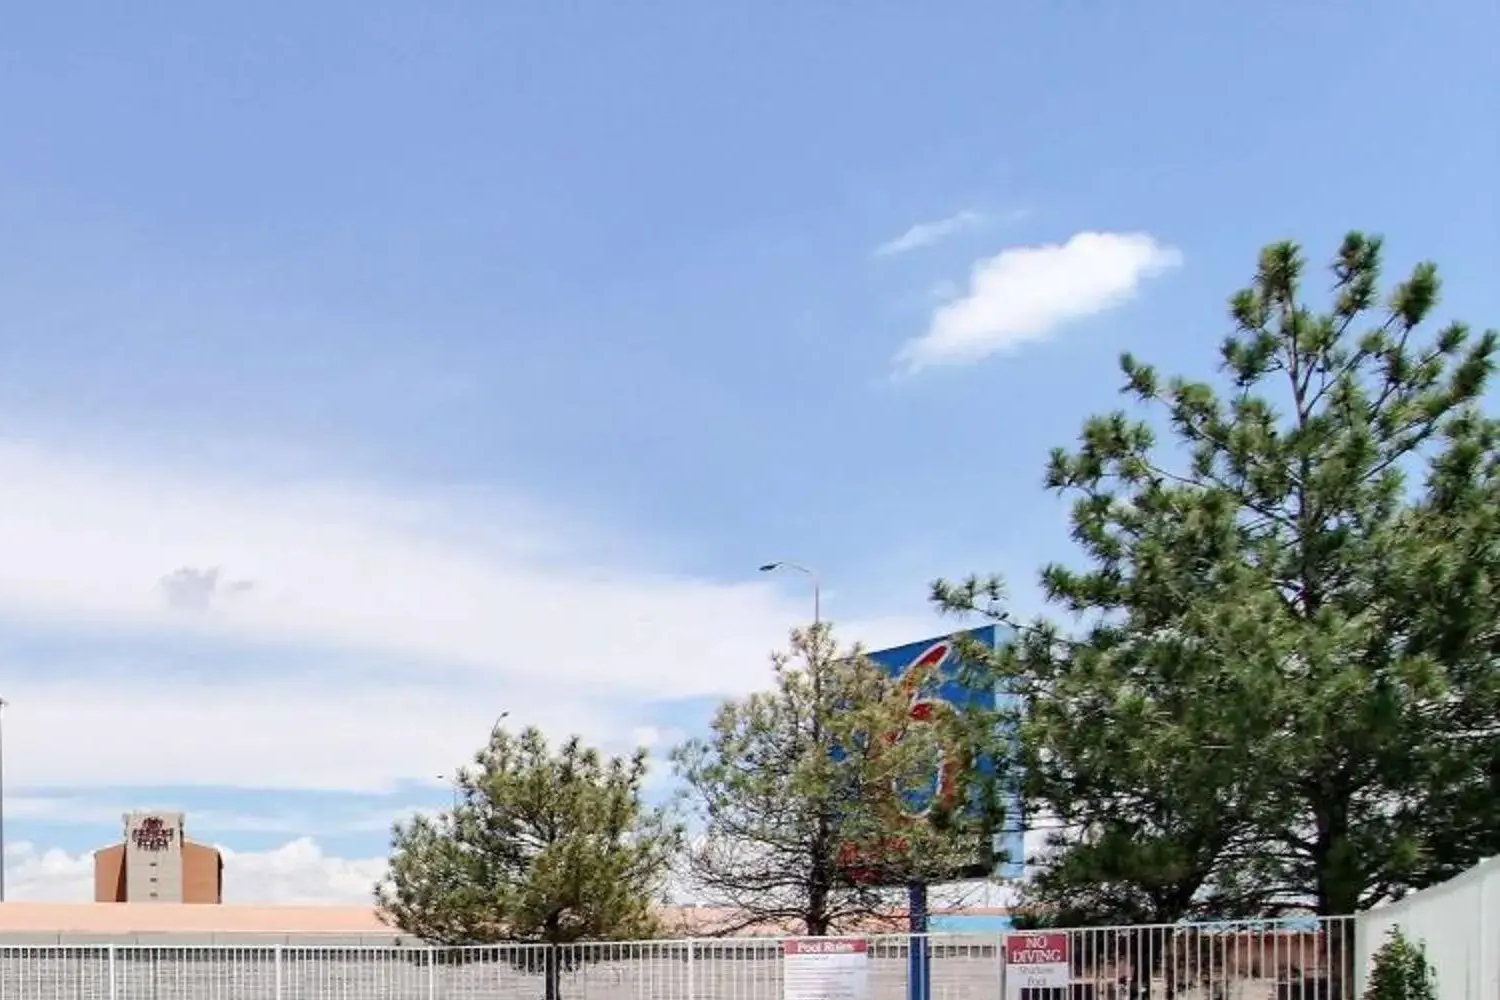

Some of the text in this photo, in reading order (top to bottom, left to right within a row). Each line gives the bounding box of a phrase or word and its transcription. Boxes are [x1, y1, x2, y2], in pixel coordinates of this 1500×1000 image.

[797, 942, 821, 954] Pool
[1025, 935, 1048, 949] NO
[1012, 948, 1061, 963] DIVING
